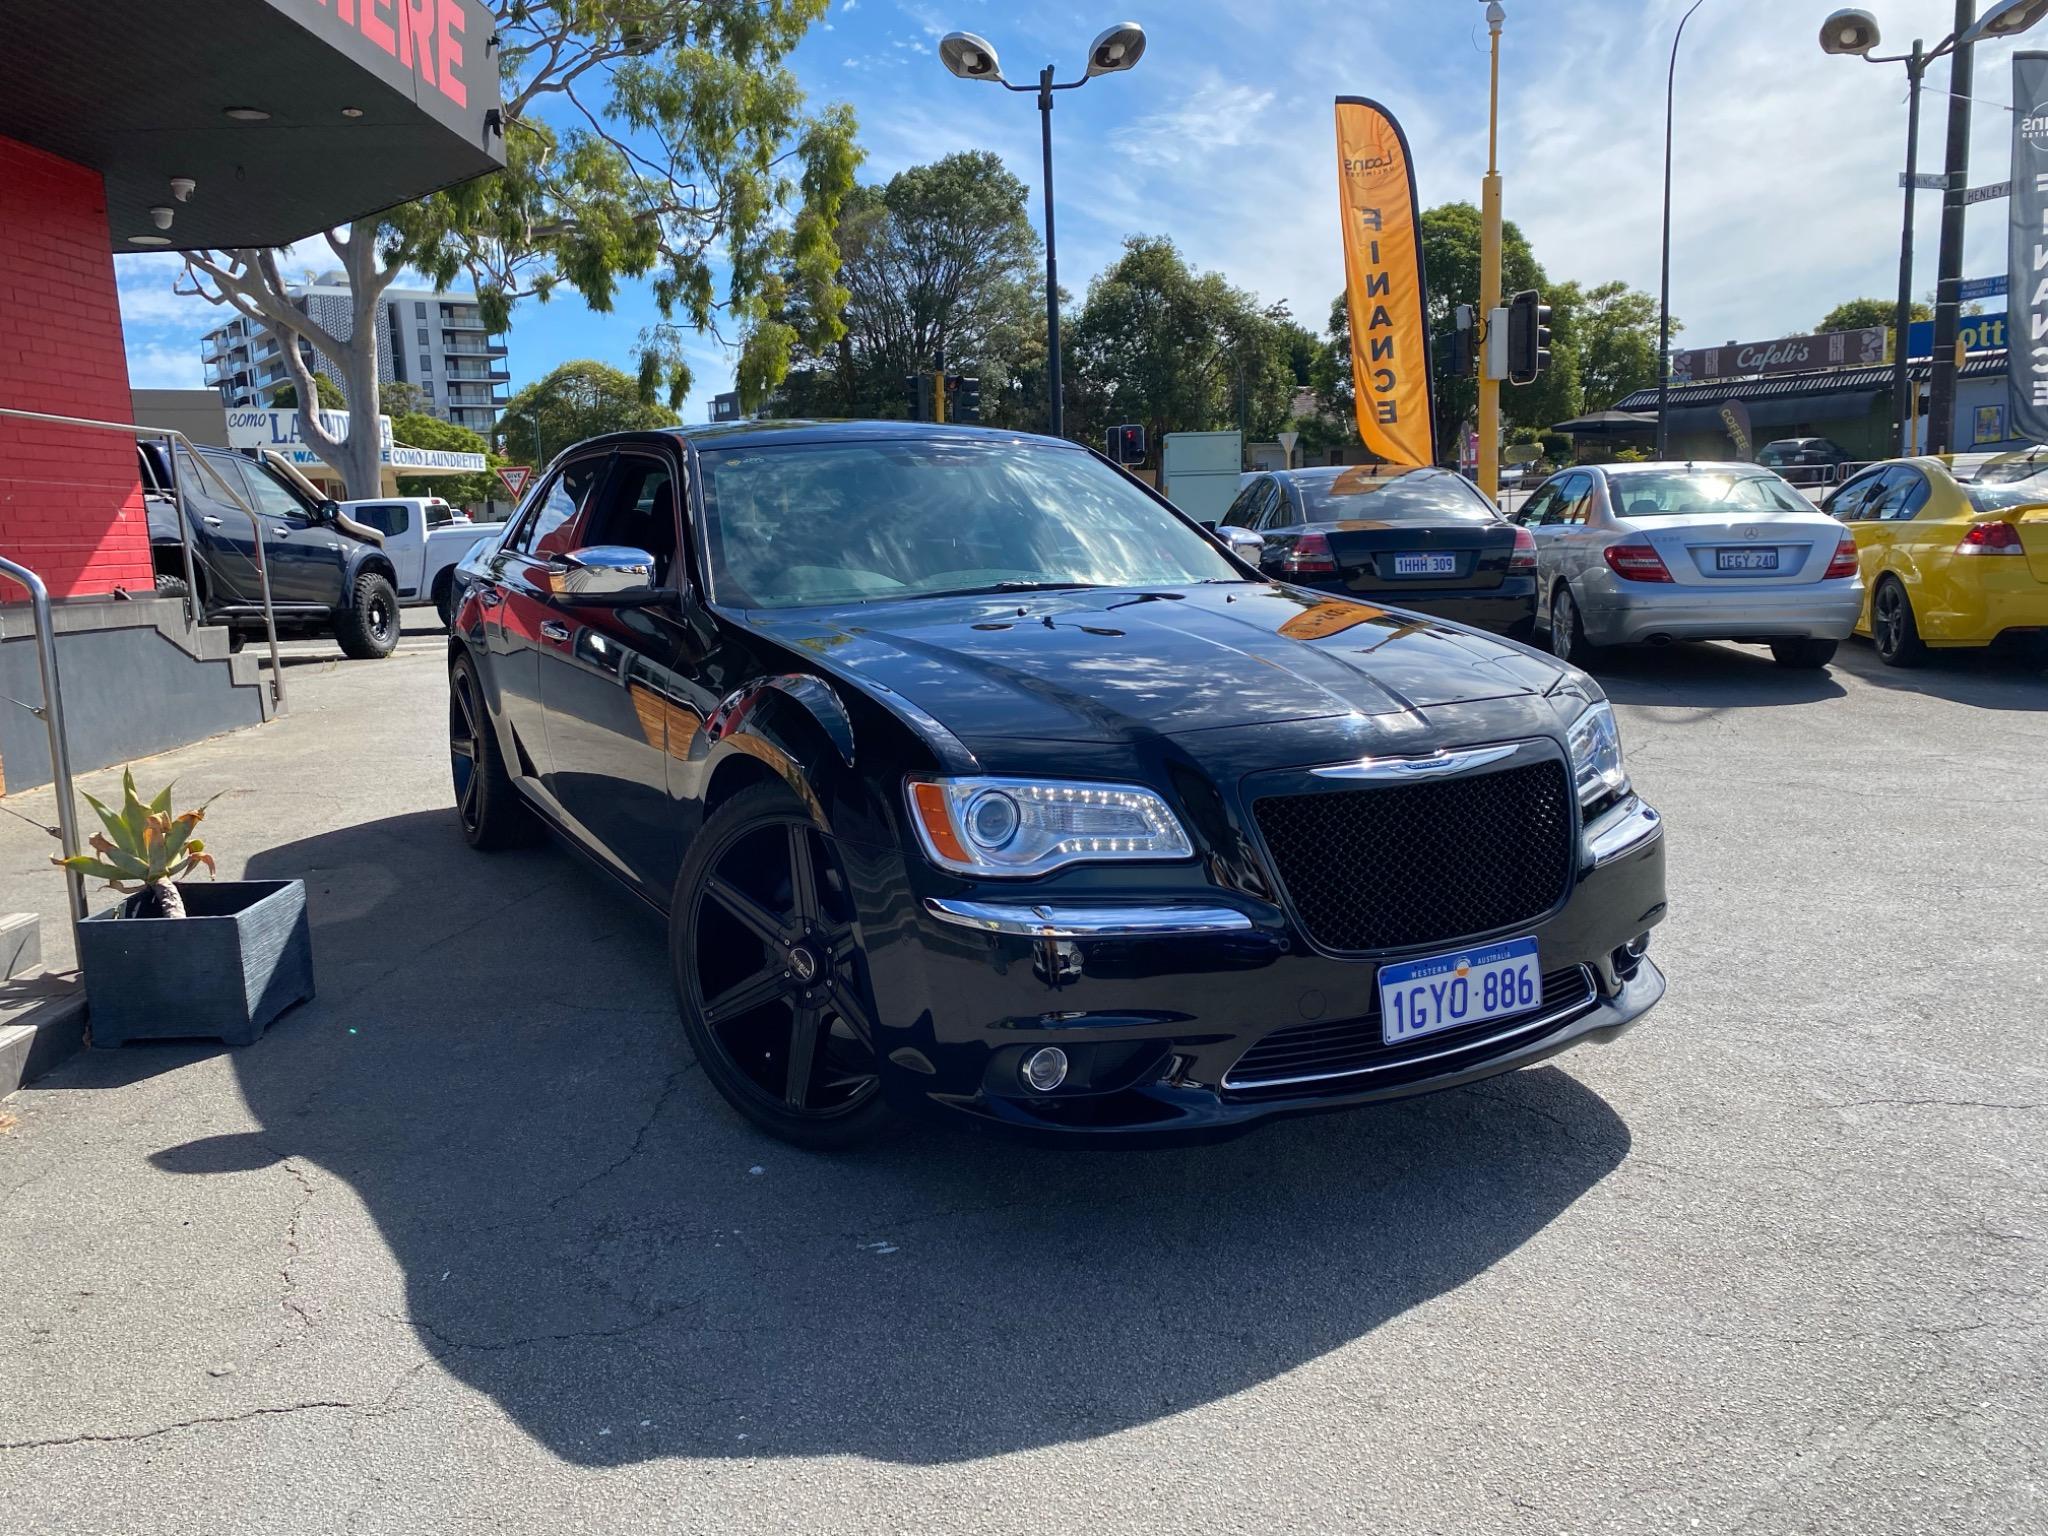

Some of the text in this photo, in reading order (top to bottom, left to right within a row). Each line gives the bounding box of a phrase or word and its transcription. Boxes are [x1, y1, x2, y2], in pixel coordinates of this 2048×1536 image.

[318, 0, 467, 109] ERE
[1968, 186, 2003, 202] HENLEY
[1737, 343, 1809, 371] Cafeli's
[1721, 408, 1749, 451] COFFEE
[393, 451, 422, 464] COMO
[425, 453, 483, 468] LAUNDRETTE
[1411, 952, 1511, 979] WESTERN AUSTRALIA
